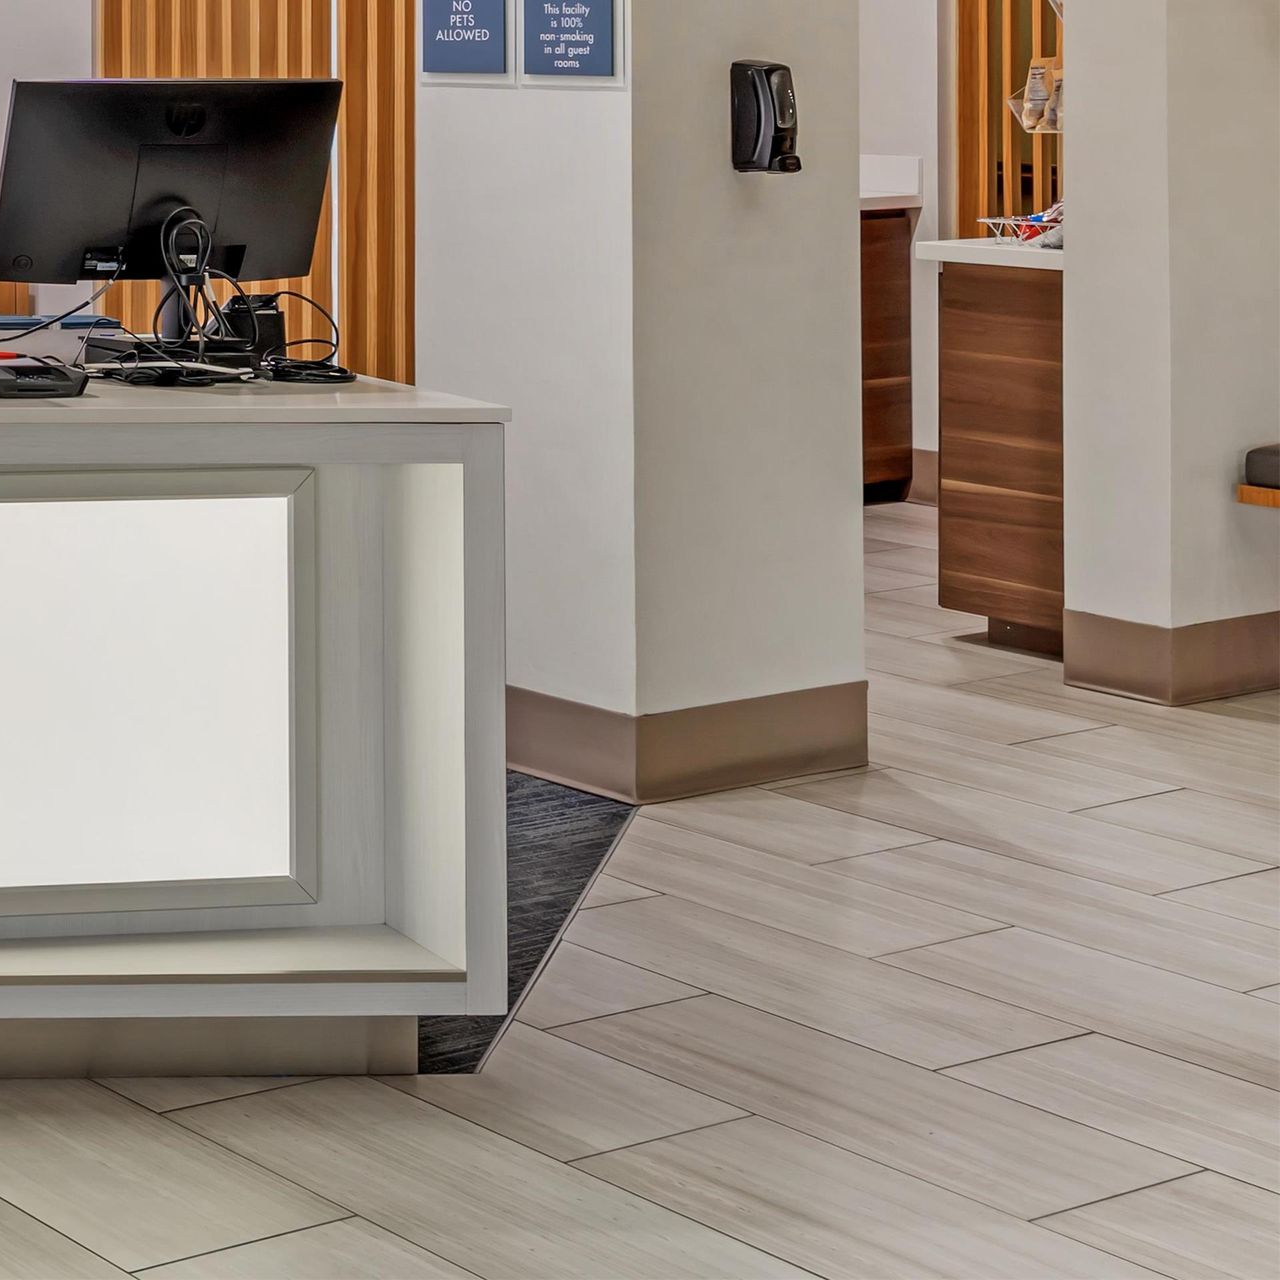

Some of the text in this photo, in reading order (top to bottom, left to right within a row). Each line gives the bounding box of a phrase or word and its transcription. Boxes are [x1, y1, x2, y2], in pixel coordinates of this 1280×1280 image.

[452, 0, 472, 12] NO
[543, 2, 591, 18] This facility
[449, 14, 475, 27] PETS
[550, 16, 584, 28] is 100%
[435, 28, 490, 41] ALLOWED
[539, 29, 594, 45] non-smoking
[543, 42, 591, 58] in all guest
[553, 60, 581, 69] rooms
